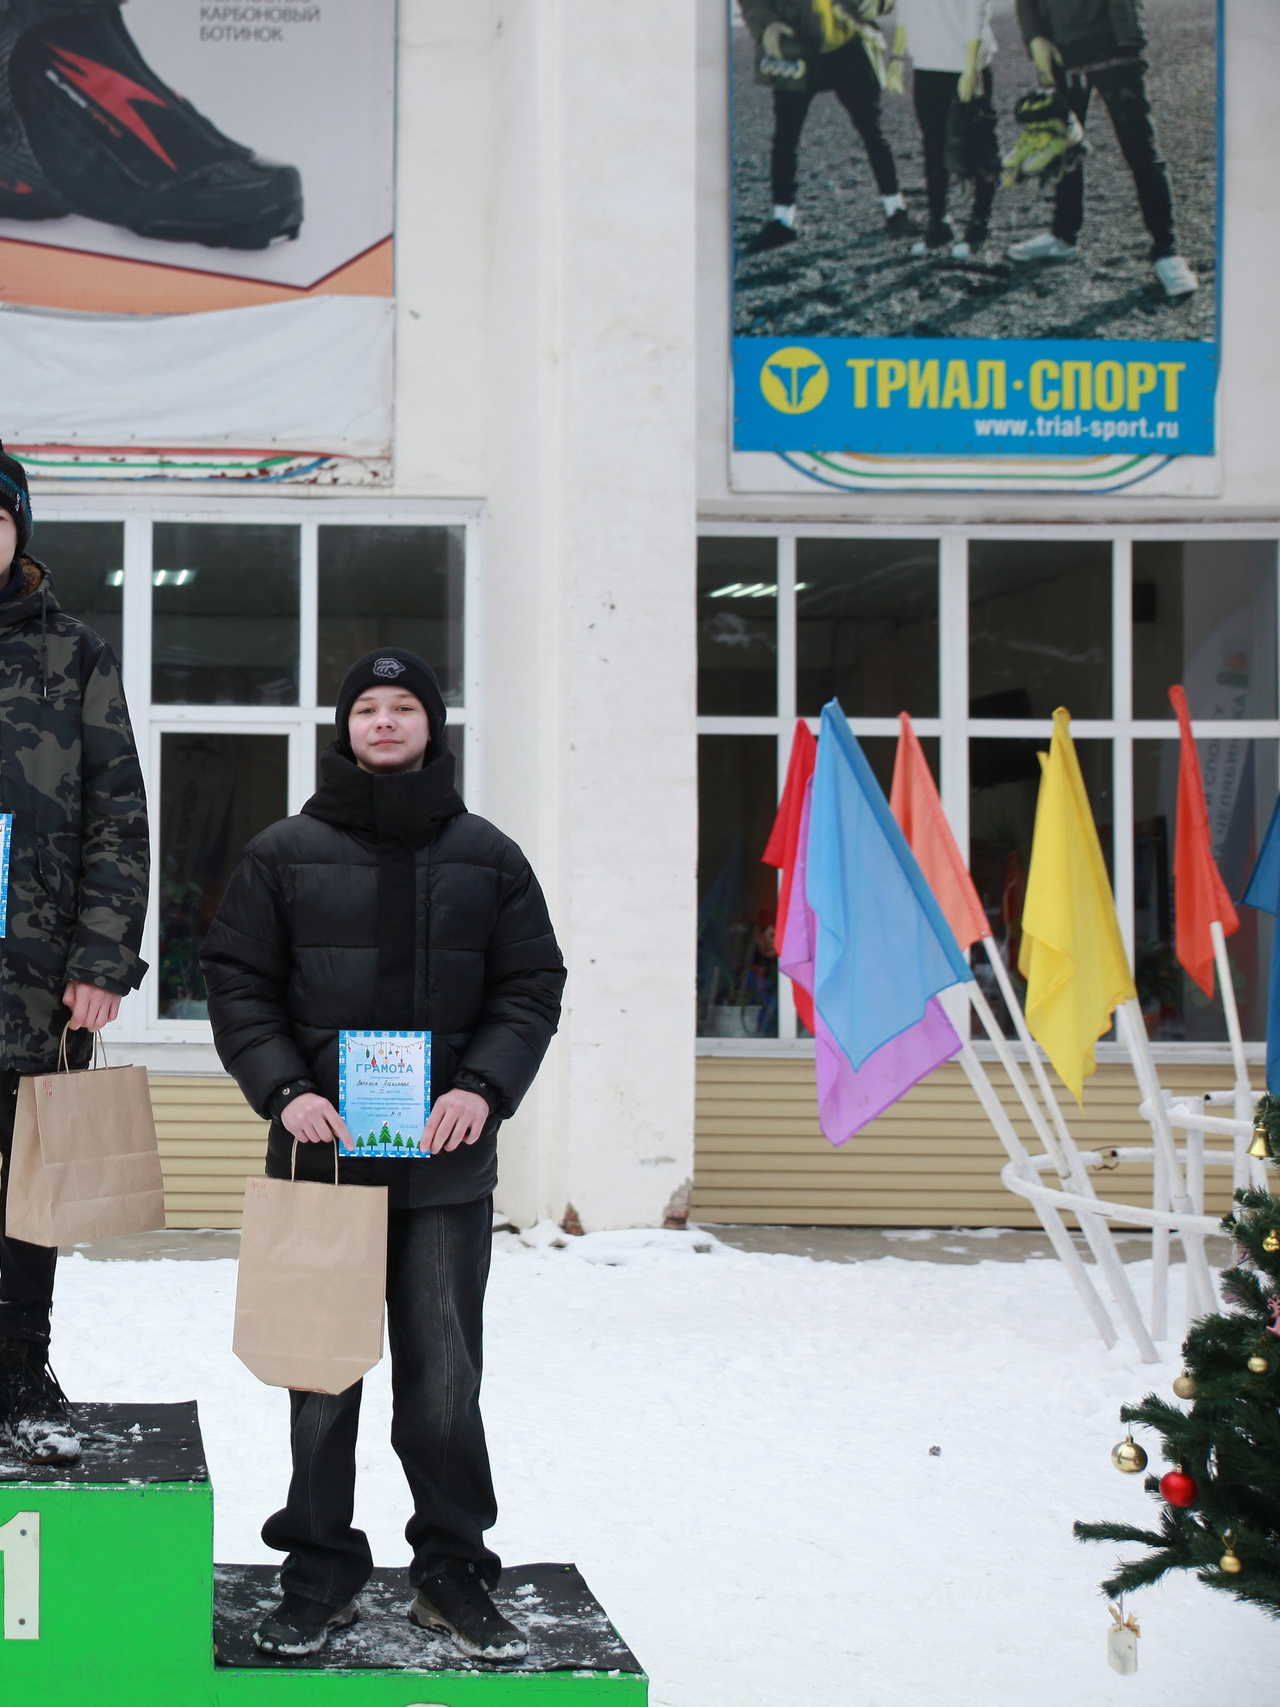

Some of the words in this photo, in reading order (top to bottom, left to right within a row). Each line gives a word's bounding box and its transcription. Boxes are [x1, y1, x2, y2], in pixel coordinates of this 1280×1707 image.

[200, 4, 320, 23] КАРБОНОВЫЙ
[200, 25, 282, 42] БОТИНОК
[975, 416, 1179, 441] www.trial-sport.ru
[356, 1063, 414, 1073] ГРАМОТА
